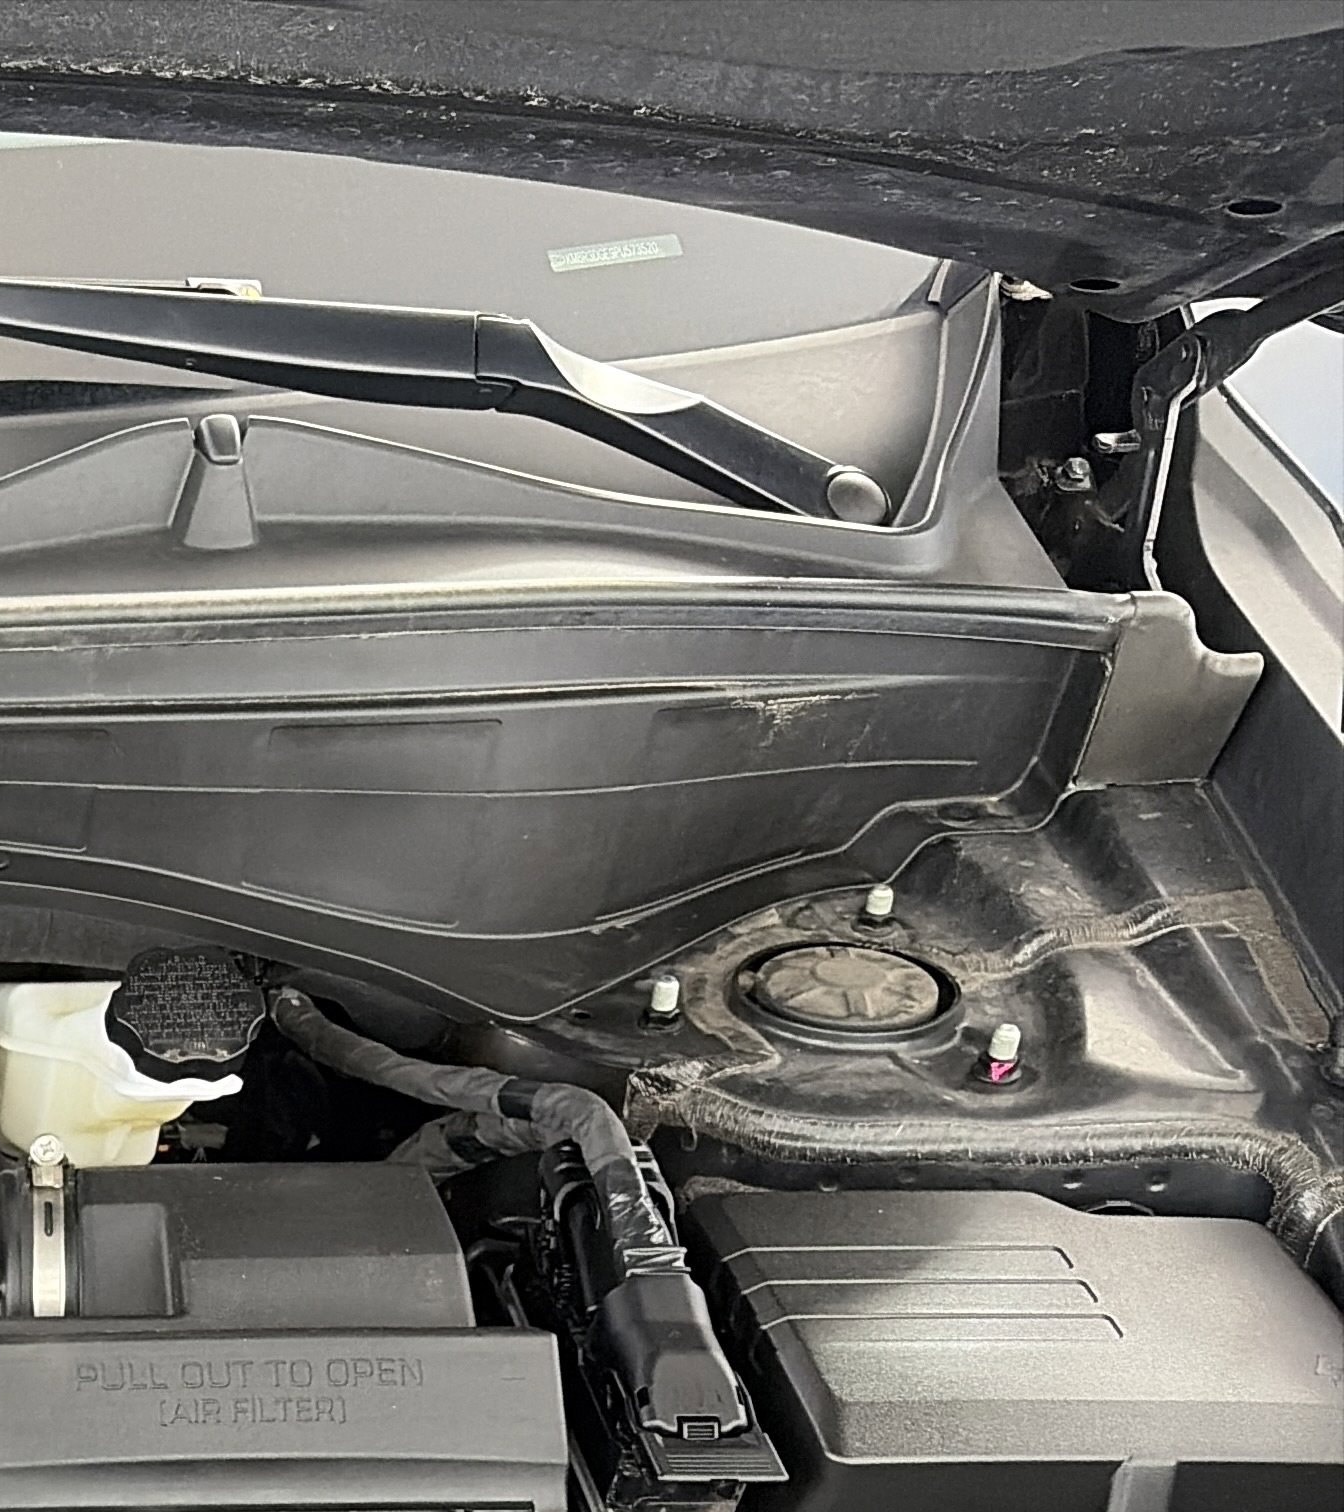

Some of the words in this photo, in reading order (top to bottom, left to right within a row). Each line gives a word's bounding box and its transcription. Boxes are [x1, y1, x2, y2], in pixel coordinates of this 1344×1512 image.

[76, 1361, 169, 1391] PULL
[181, 1360, 254, 1389] OUT
[264, 1359, 314, 1388] TO
[326, 1358, 424, 1387] OPEN
